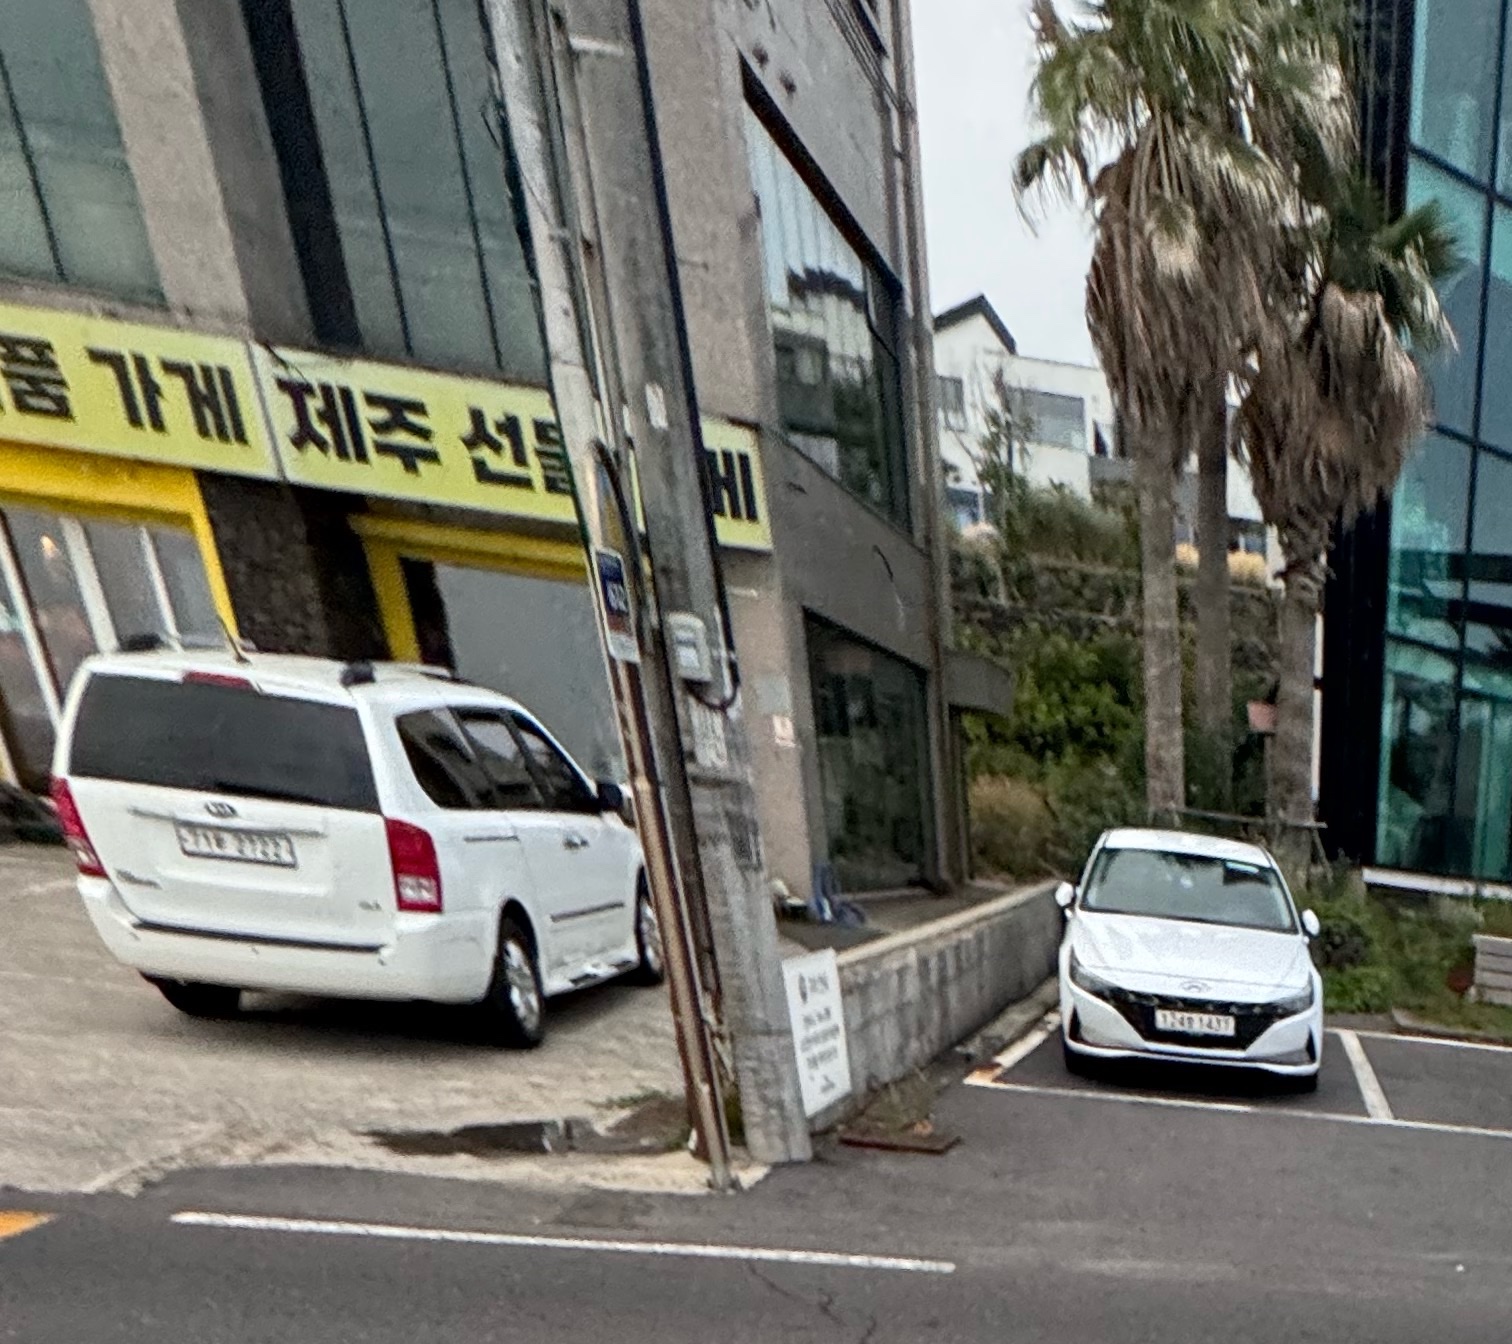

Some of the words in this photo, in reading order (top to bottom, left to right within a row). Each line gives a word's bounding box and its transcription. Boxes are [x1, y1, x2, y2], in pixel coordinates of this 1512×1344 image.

[0, 333, 76, 424] 품
[84, 344, 250, 447] 가게
[274, 374, 442, 475] 제주
